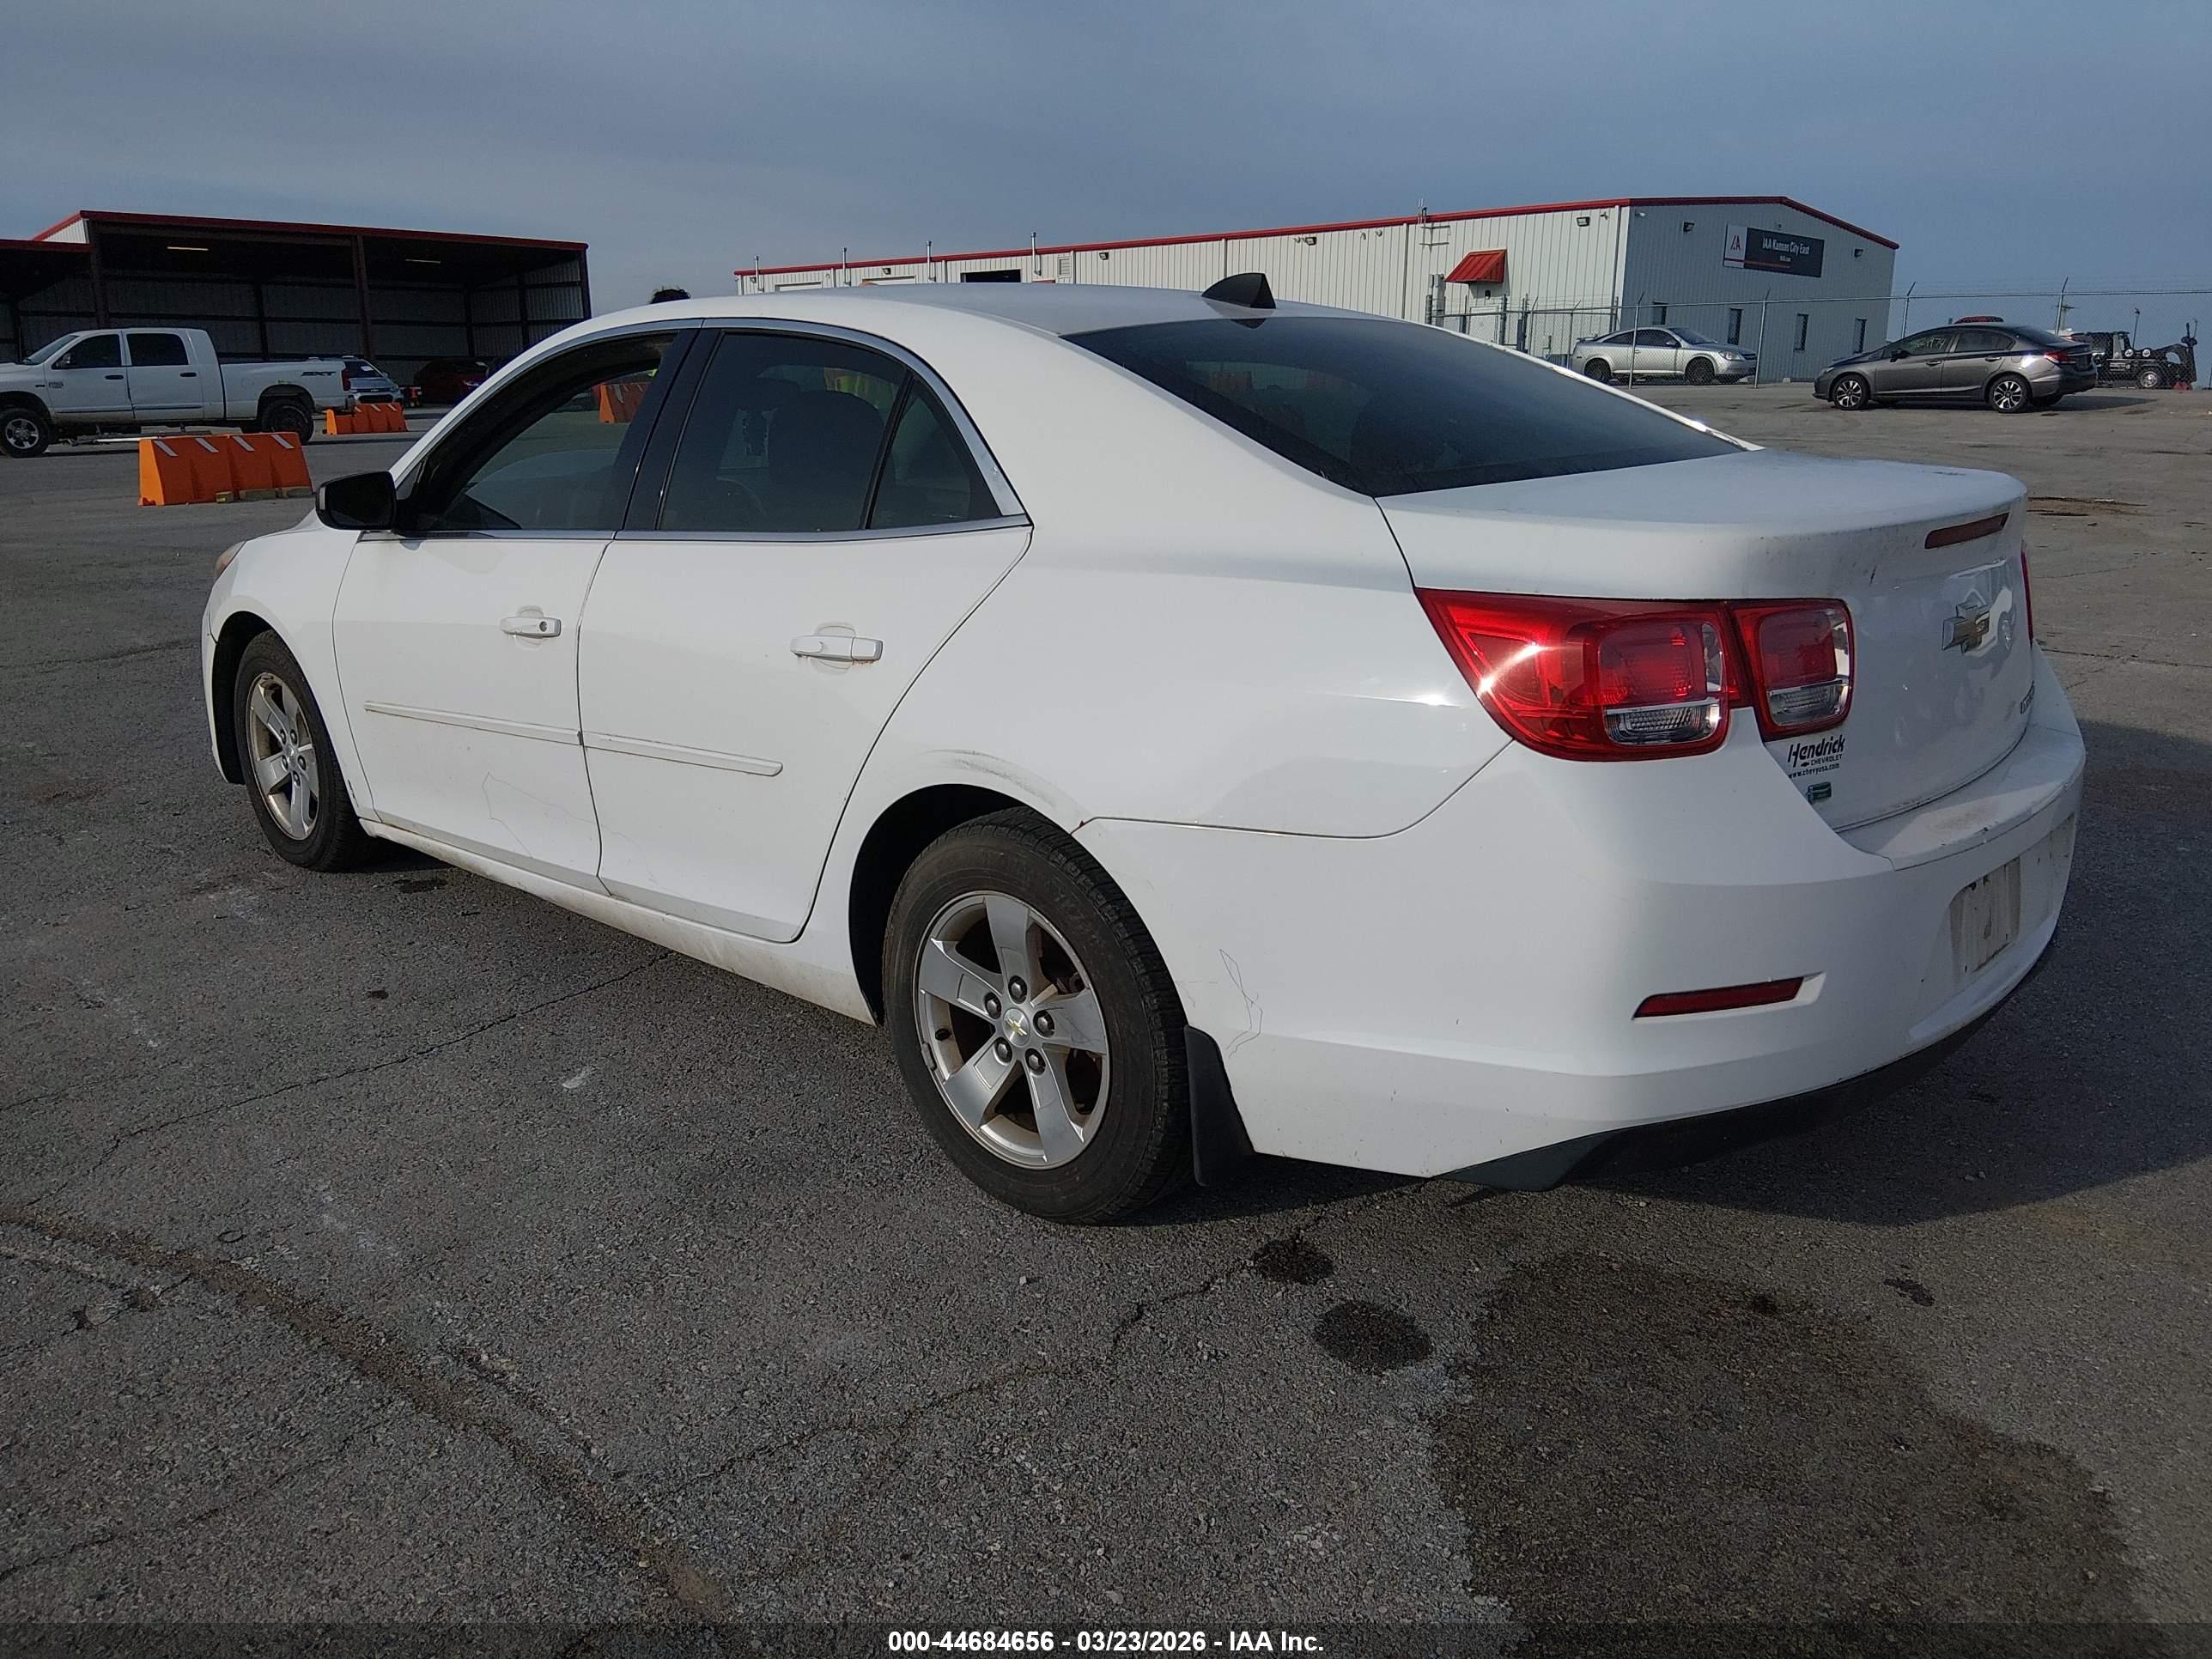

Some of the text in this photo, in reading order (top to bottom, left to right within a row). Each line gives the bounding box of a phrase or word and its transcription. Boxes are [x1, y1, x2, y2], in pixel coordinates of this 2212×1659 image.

[1772, 239, 1790, 252] Kansas
[1790, 241, 1799, 255] City
[1800, 243, 1809, 255] East
[1787, 734, 1845, 768] Hendrick
[1810, 754, 1842, 766] CHEVROLET
